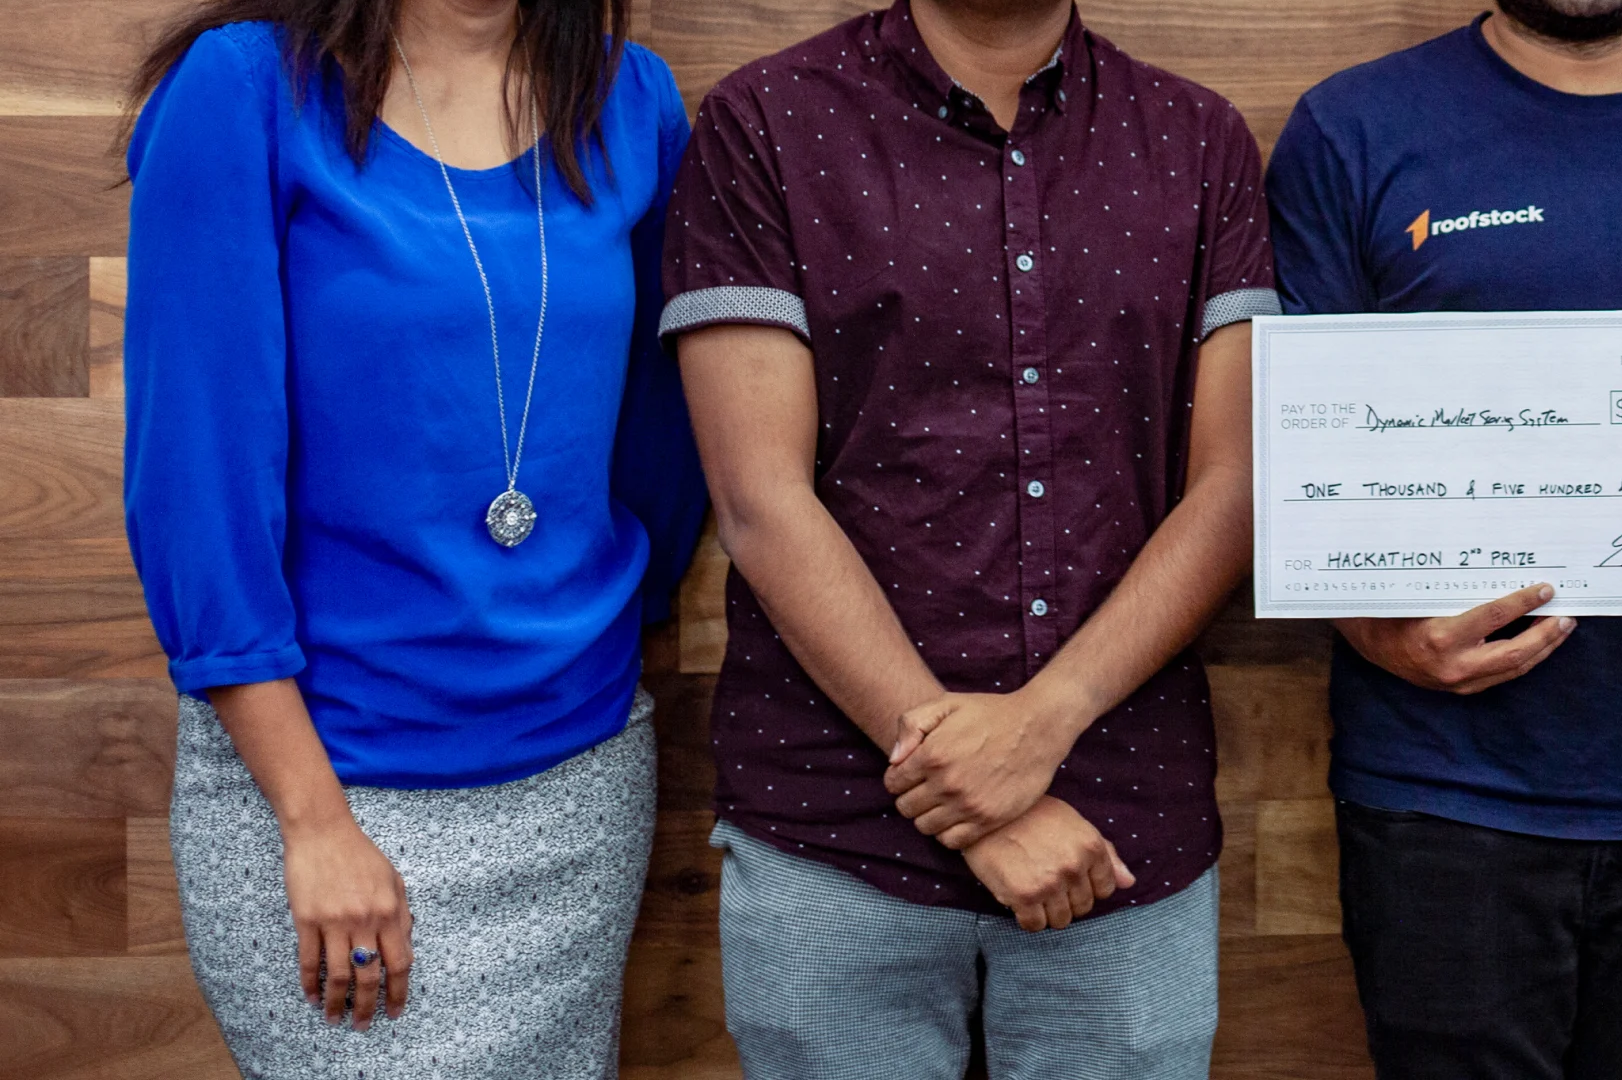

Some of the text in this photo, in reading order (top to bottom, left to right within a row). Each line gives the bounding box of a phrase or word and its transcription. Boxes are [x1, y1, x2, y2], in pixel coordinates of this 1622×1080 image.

[1431, 205, 1544, 235] roofstock
[1281, 403, 1356, 415] PAY TO THE
[1281, 418, 1349, 429] ORDER OF
[1365, 404, 1425, 433] Dynamic
[1301, 482, 1342, 498] ONE
[1362, 482, 1448, 498] THOUSAND
[1492, 482, 1525, 495] FIVE
[1539, 483, 1602, 495] HUNDRED
[1284, 559, 1312, 570] FOR
[1327, 551, 1442, 568] HACKATHON
[1491, 551, 1536, 566] PRIZE
